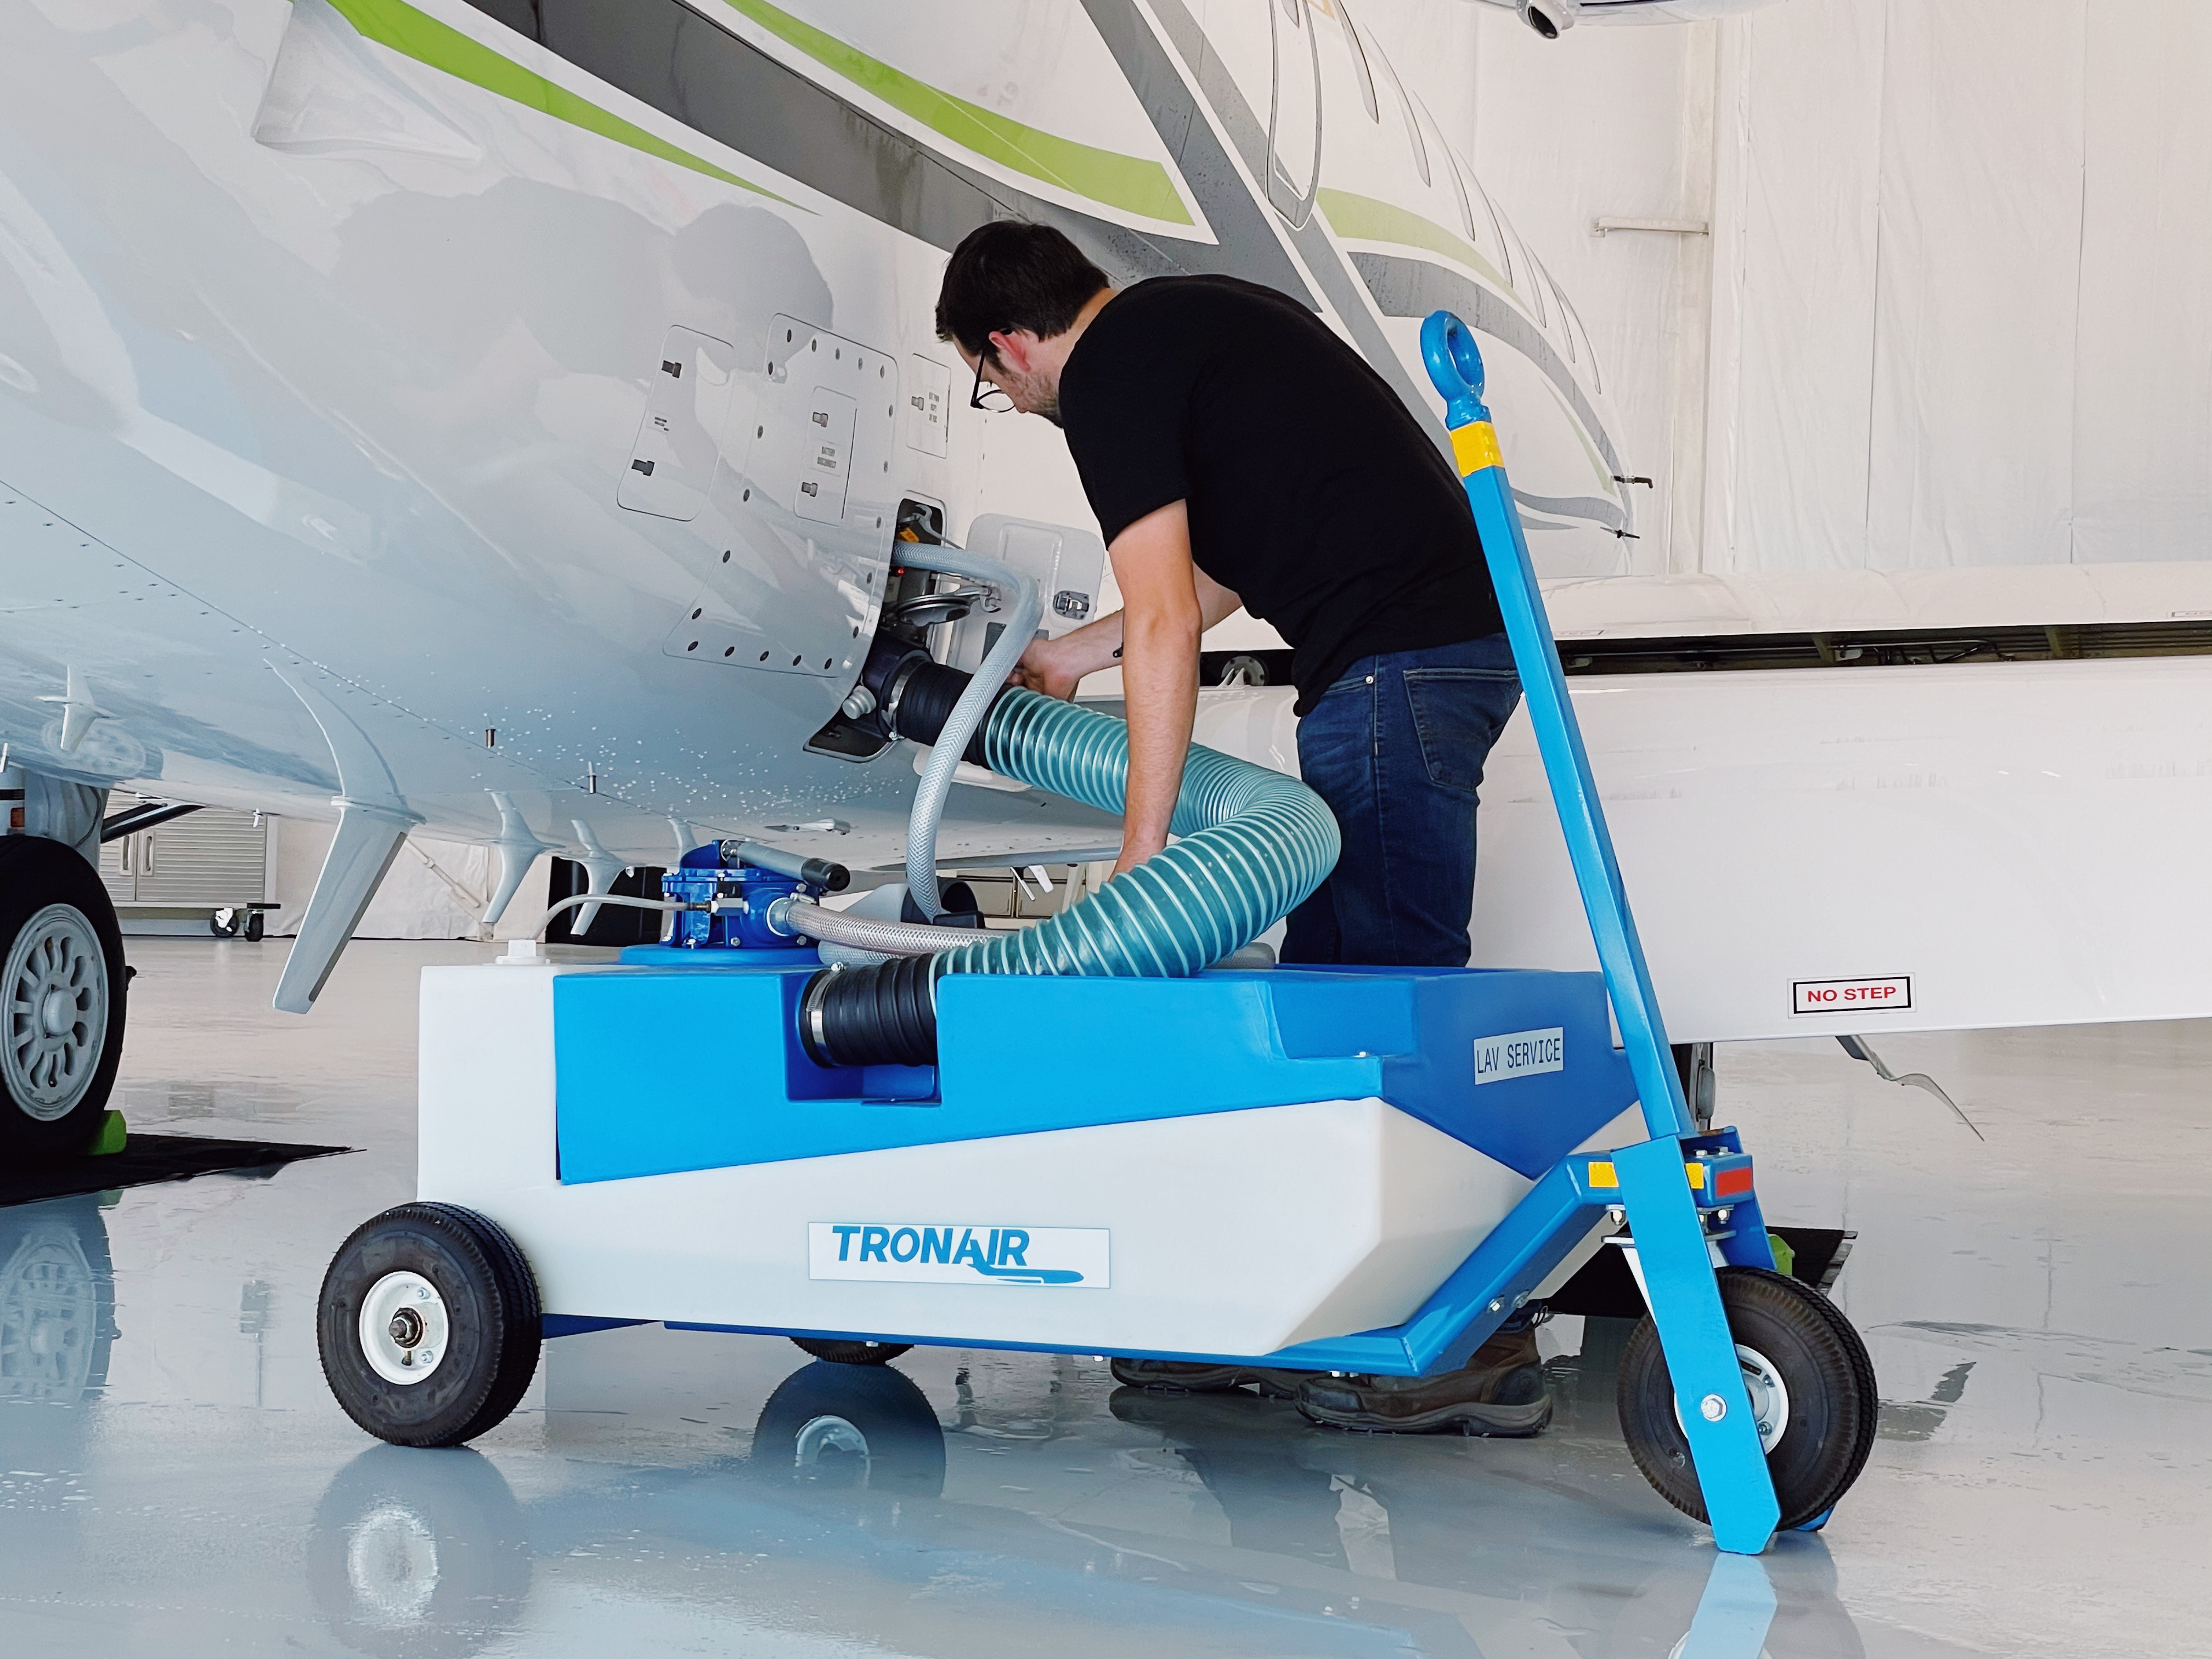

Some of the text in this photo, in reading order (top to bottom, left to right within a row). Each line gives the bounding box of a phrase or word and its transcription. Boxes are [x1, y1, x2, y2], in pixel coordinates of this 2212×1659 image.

[1808, 986, 1896, 1002] NO STEP
[1477, 1038, 1560, 1074] LAV SERVICE
[832, 1225, 1030, 1266] TRONAIR
